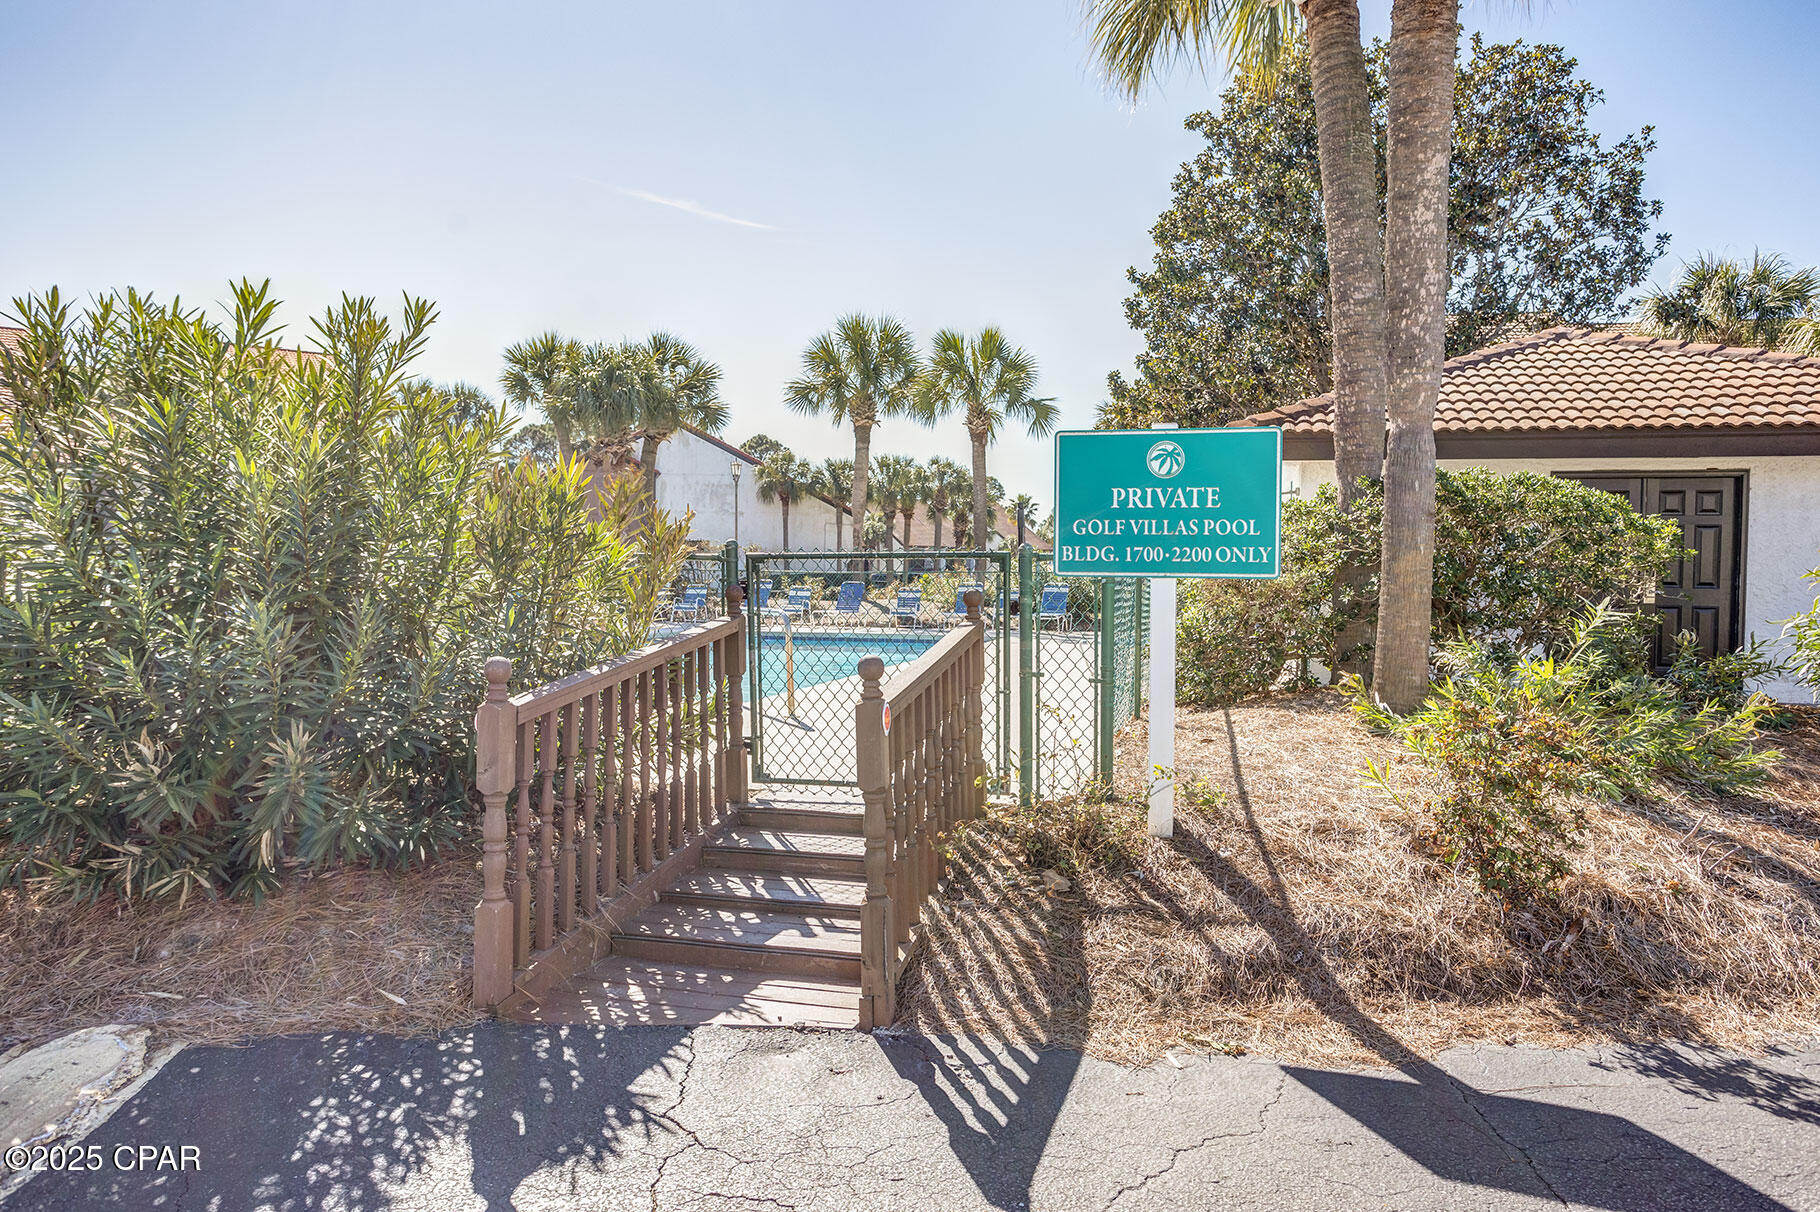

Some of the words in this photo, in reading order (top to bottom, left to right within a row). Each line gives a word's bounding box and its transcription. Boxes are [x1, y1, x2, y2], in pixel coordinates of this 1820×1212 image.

[1110, 486, 1222, 509] PRIVATE
[1072, 518, 1126, 536] GOLF
[1129, 518, 1199, 536] VILLAS
[1203, 518, 1261, 536] POOL
[1062, 545, 1120, 562] BLDG.
[1215, 546, 1273, 563] ONLY
